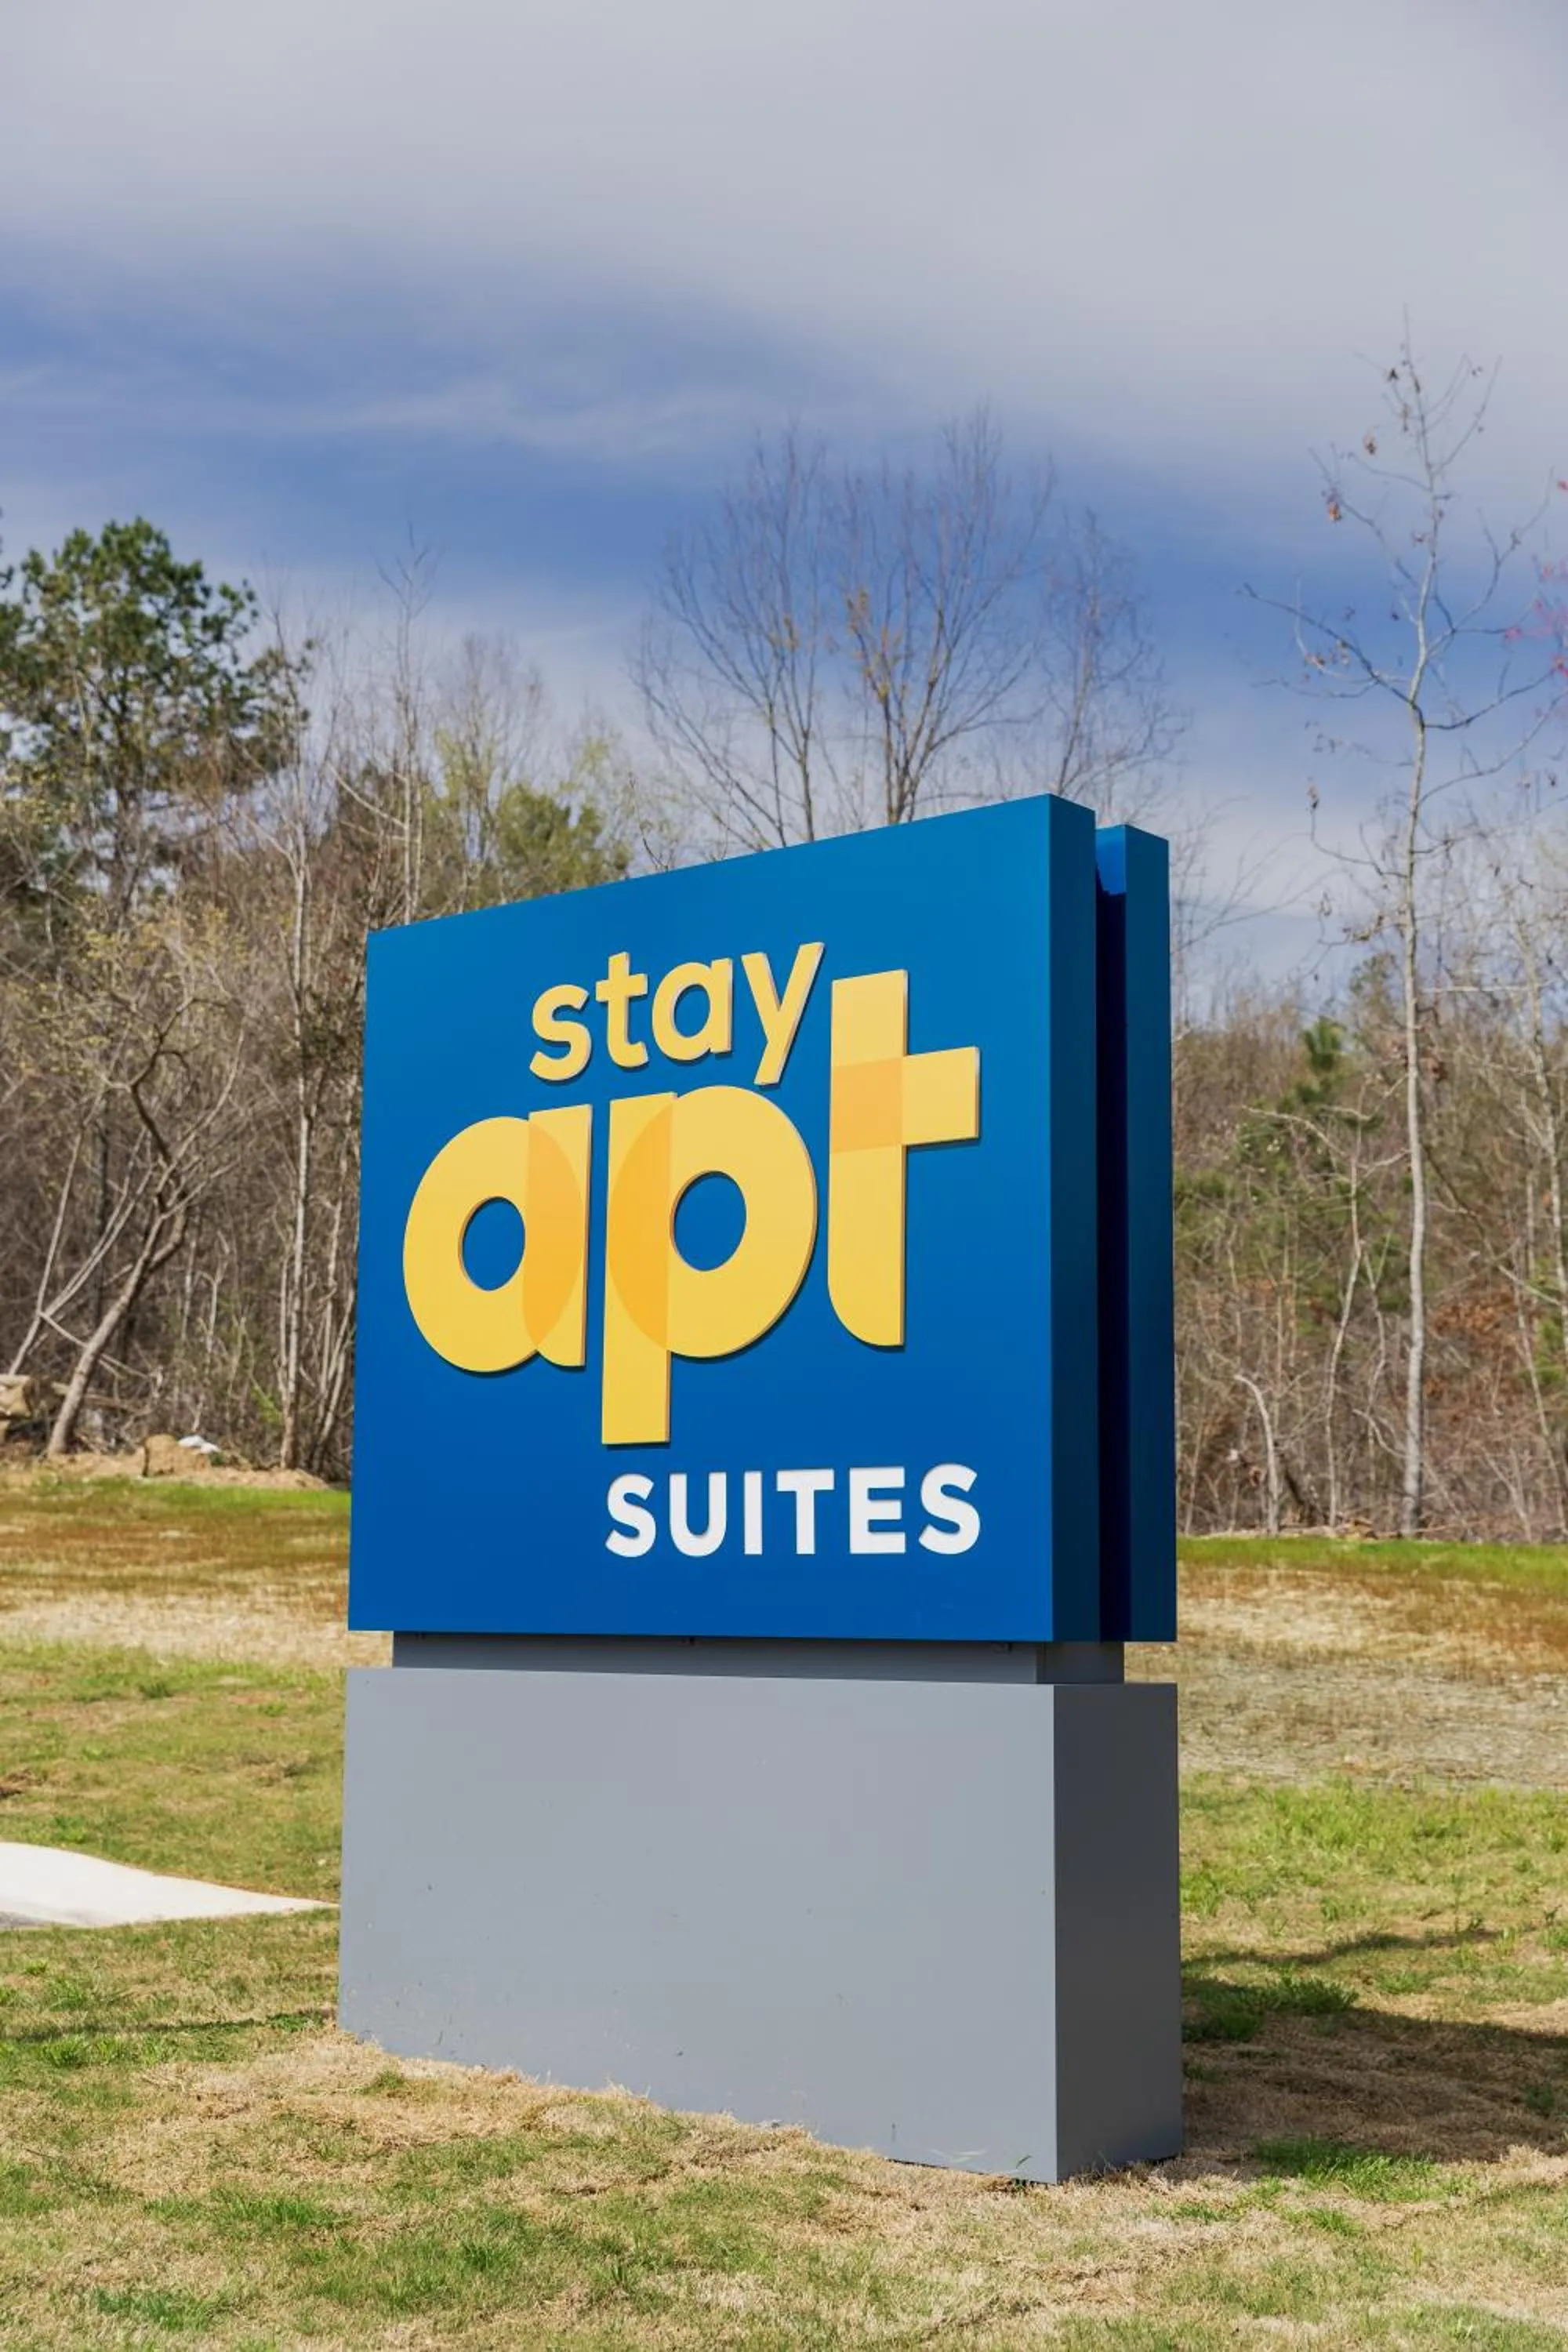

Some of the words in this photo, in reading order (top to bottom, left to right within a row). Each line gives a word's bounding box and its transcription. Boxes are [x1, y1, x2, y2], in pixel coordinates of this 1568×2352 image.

[529, 942, 824, 1084] stay
[403, 969, 981, 1445] apt
[605, 1464, 981, 1557] SUITES
